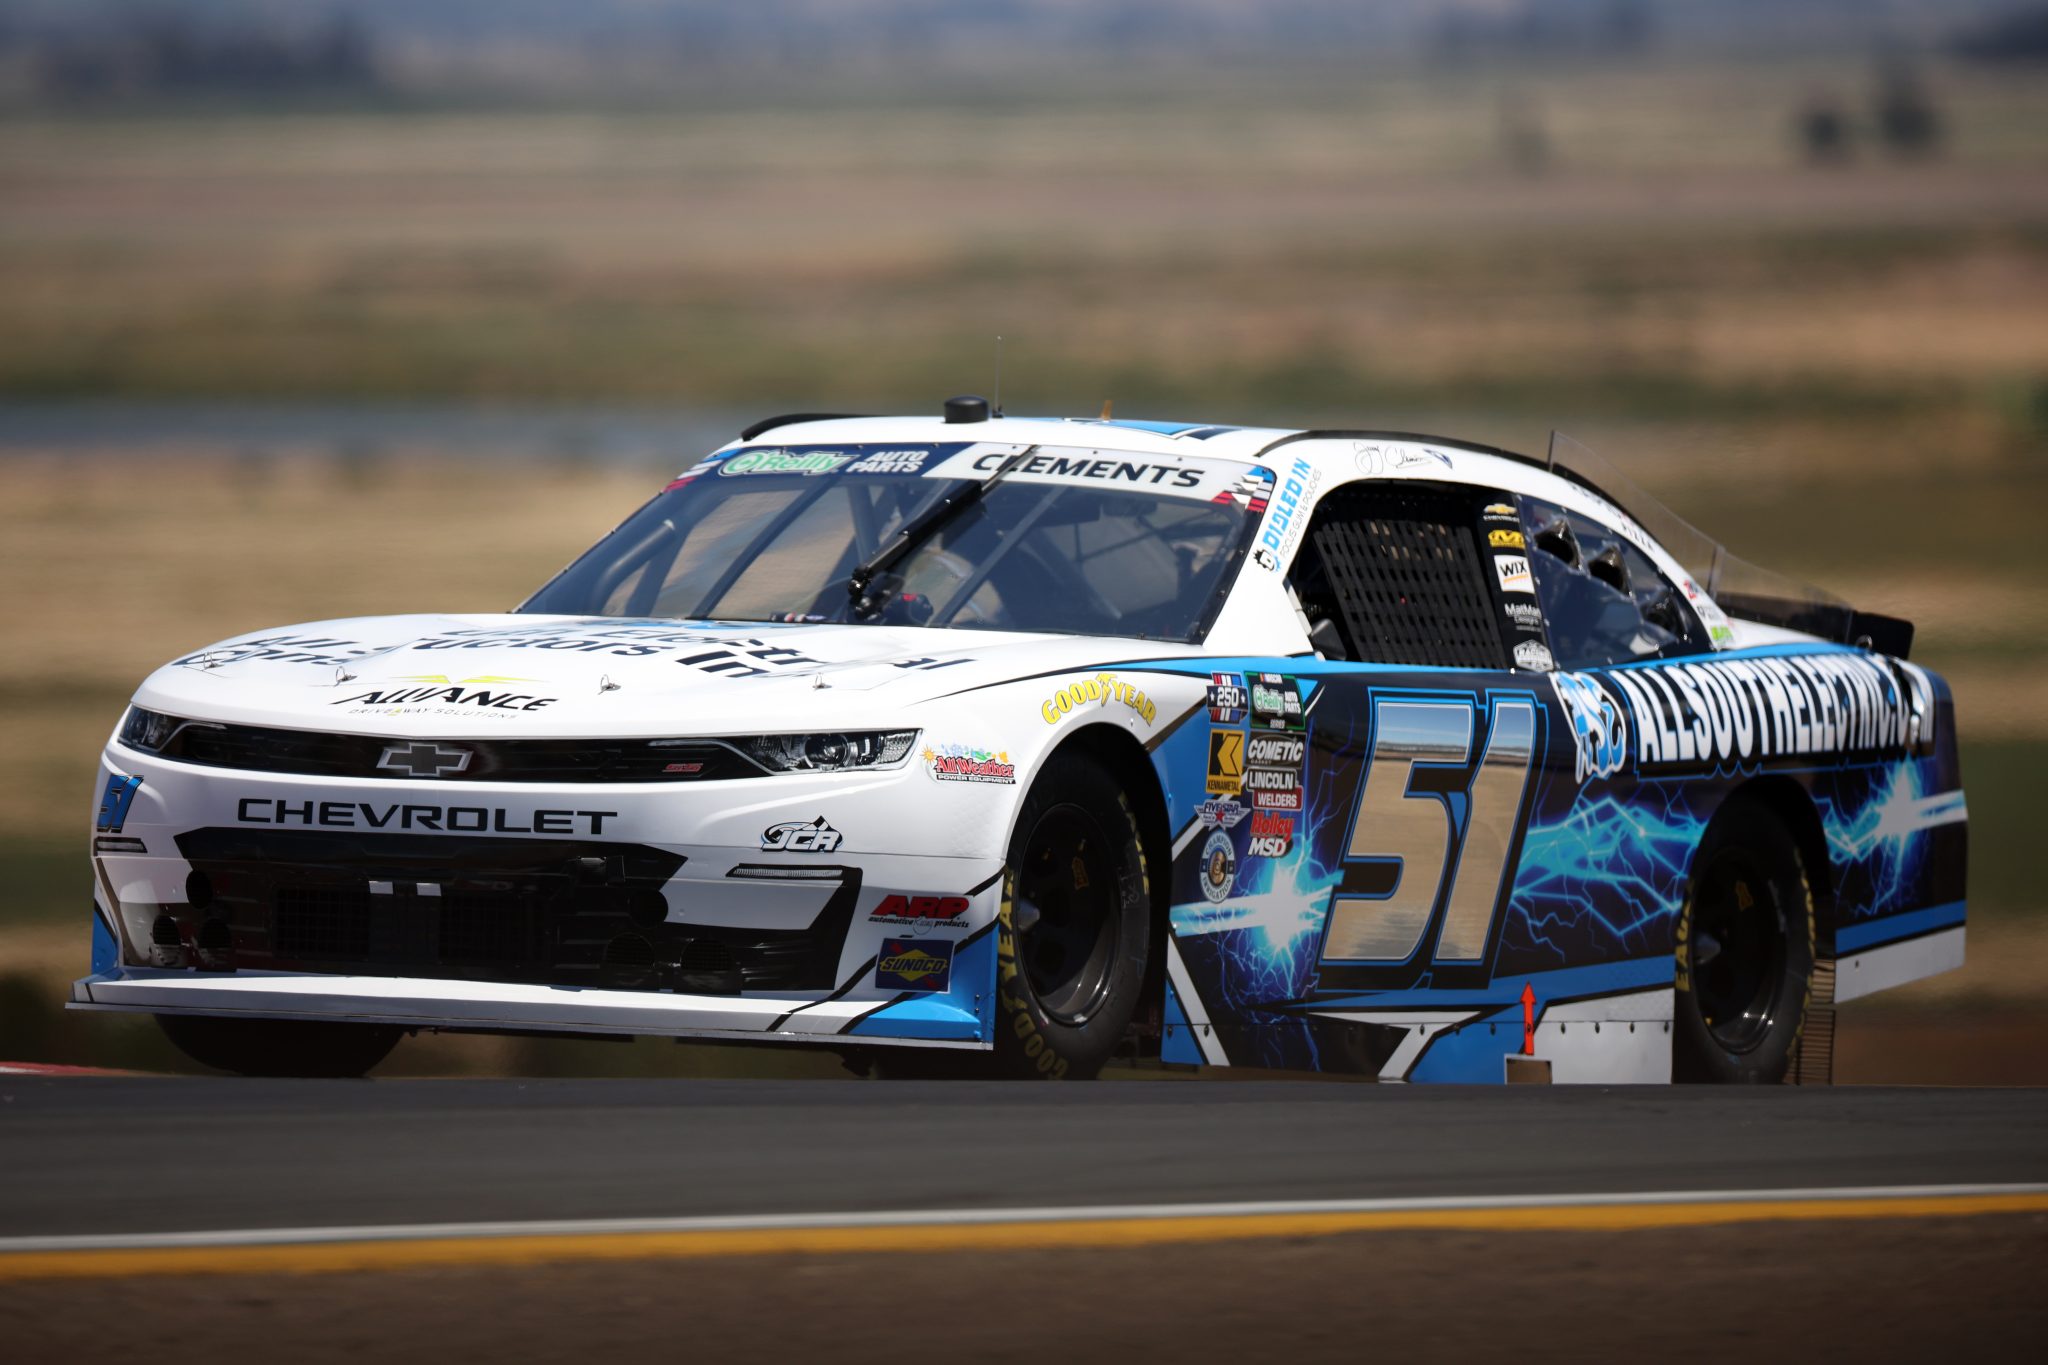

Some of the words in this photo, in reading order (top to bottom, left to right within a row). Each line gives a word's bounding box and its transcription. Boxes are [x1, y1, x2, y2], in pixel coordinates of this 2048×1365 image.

[864, 451, 928, 463] AUTO
[846, 462, 922, 473] PARTS
[972, 454, 1205, 487] CLEMENTS
[1500, 560, 1528, 577] WIX
[1217, 687, 1239, 707] 250
[433, 708, 520, 720] SOLUTIONS
[1248, 739, 1304, 762] COMETIC
[956, 757, 1015, 778] Weather
[969, 776, 1014, 785] EQUIPMENT
[1208, 780, 1240, 792] KENNAMETAL
[1250, 769, 1294, 790] LINCOLN
[1258, 792, 1298, 808] WELDERS
[237, 797, 618, 835] CHEVROLET
[1251, 811, 1295, 843] Holley
[1318, 697, 1536, 966] 51
[762, 829, 838, 853] JCR
[1248, 837, 1287, 857] MSD
[871, 895, 970, 919] ARP
[868, 916, 914, 926] automotive
[934, 920, 970, 928] products
[882, 957, 946, 972] SUNOCO
